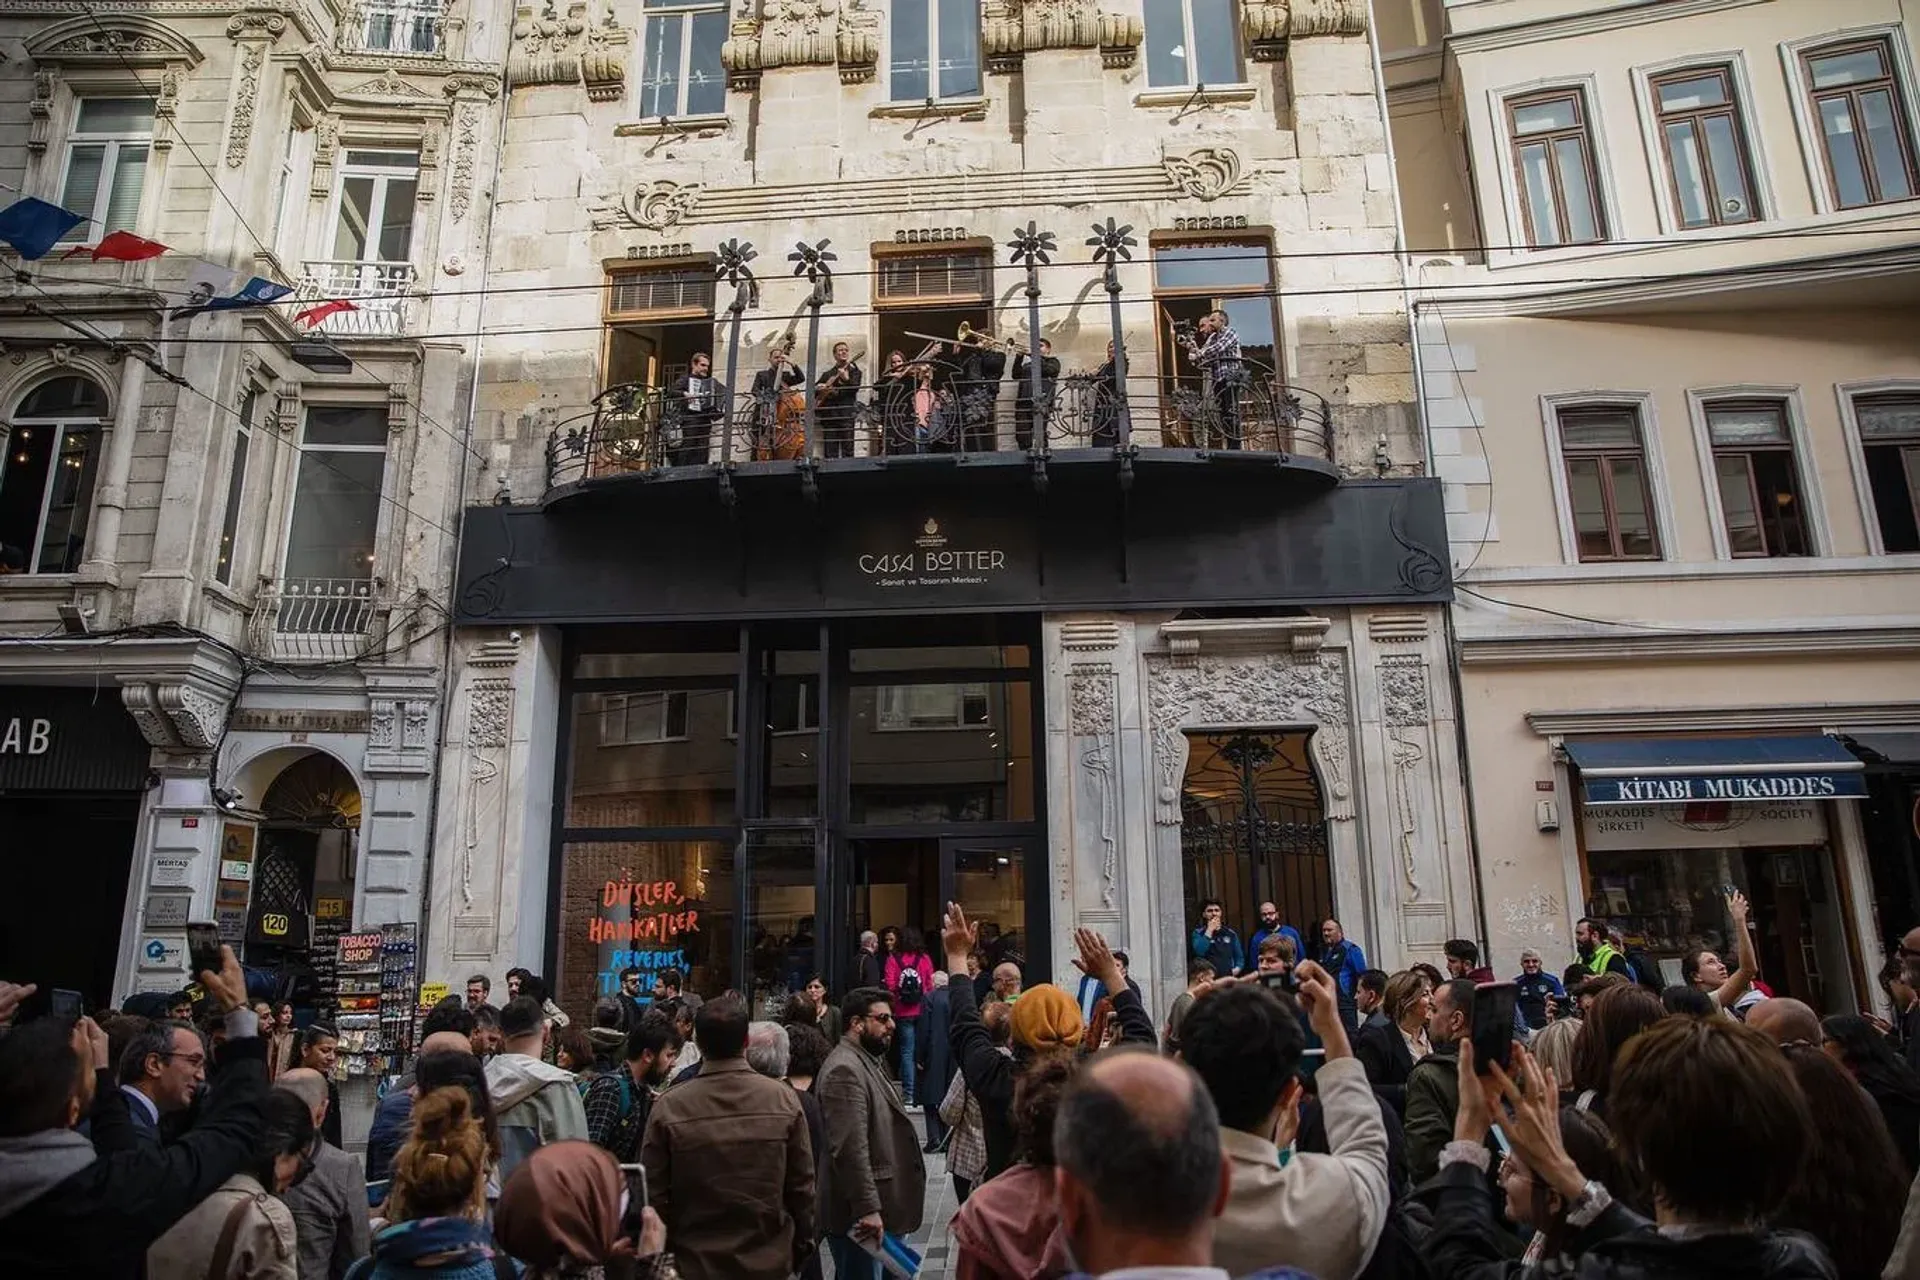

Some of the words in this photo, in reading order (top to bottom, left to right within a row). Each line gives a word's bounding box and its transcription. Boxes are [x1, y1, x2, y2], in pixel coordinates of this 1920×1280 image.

[859, 553, 914, 573] CASA
[926, 551, 1005, 571] BOTTER
[880, 578, 906, 586] Sanat
[919, 577, 951, 585] Tasarım
[952, 576, 982, 584] Merkezi
[0, 717, 51, 754] AB
[1617, 776, 1693, 800] KİTABI
[1703, 776, 1836, 799] MUKADDES
[1584, 807, 1656, 819] MUKADDES
[1759, 808, 1812, 820] SOCIETY
[1597, 819, 1645, 833] ŞİRKETİ
[264, 915, 287, 931] 120
[338, 934, 381, 949] TOBACCO
[344, 949, 373, 962] SHOP
[610, 949, 691, 974] REVERIES,
